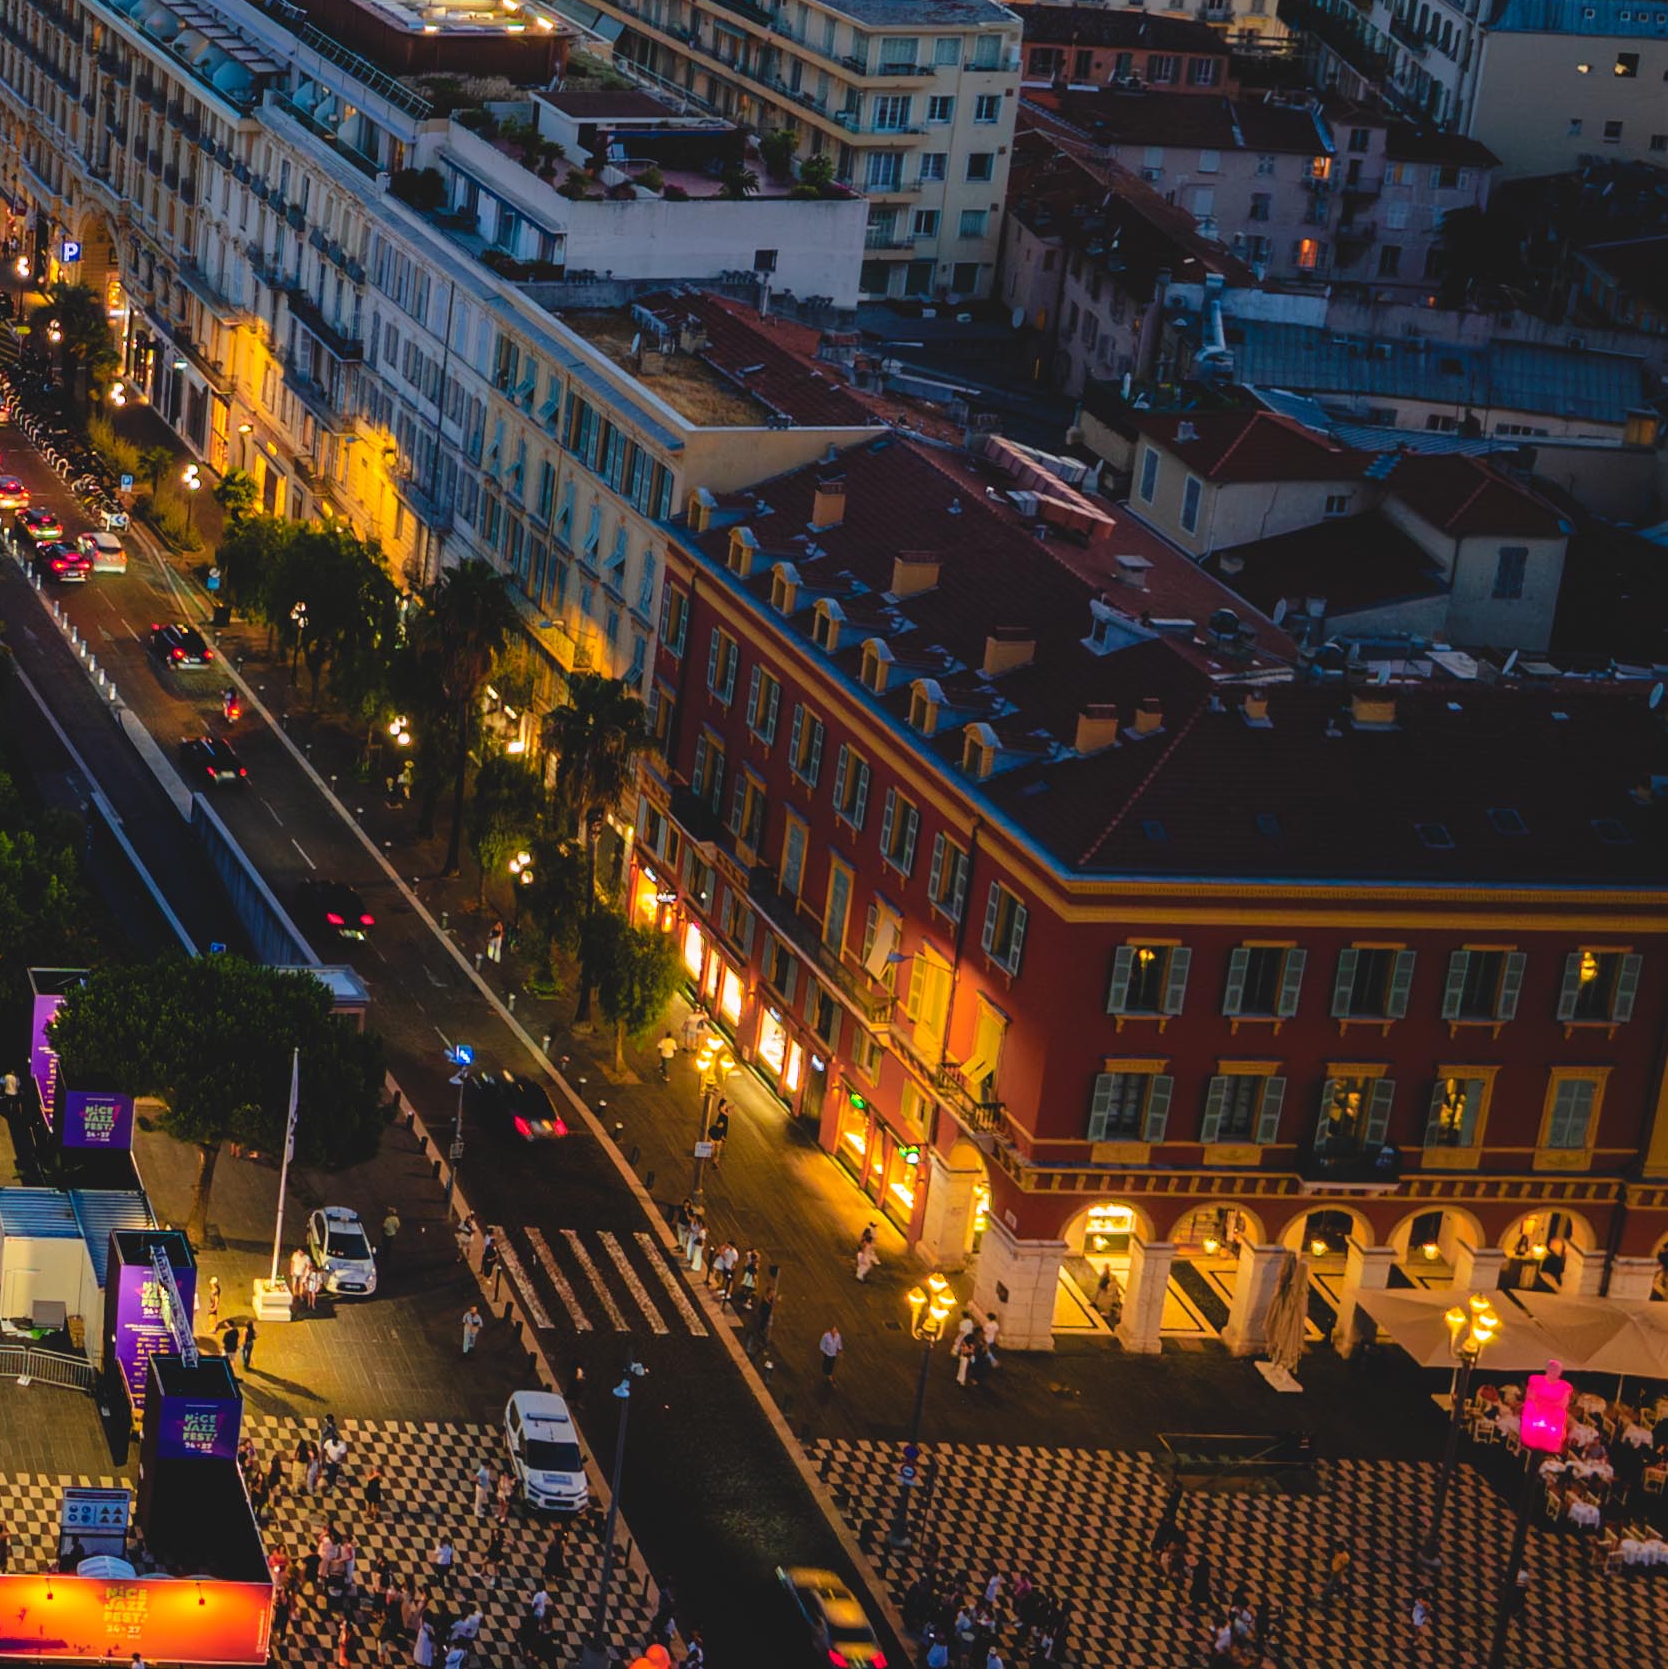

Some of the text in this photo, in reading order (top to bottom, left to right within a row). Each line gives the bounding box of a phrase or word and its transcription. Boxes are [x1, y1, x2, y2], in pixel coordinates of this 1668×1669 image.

[64, 243, 78, 262] P
[85, 1113, 113, 1123] JAZZ
[183, 1420, 217, 1431] JAZZ
[104, 1598, 148, 1611] JAZZ
